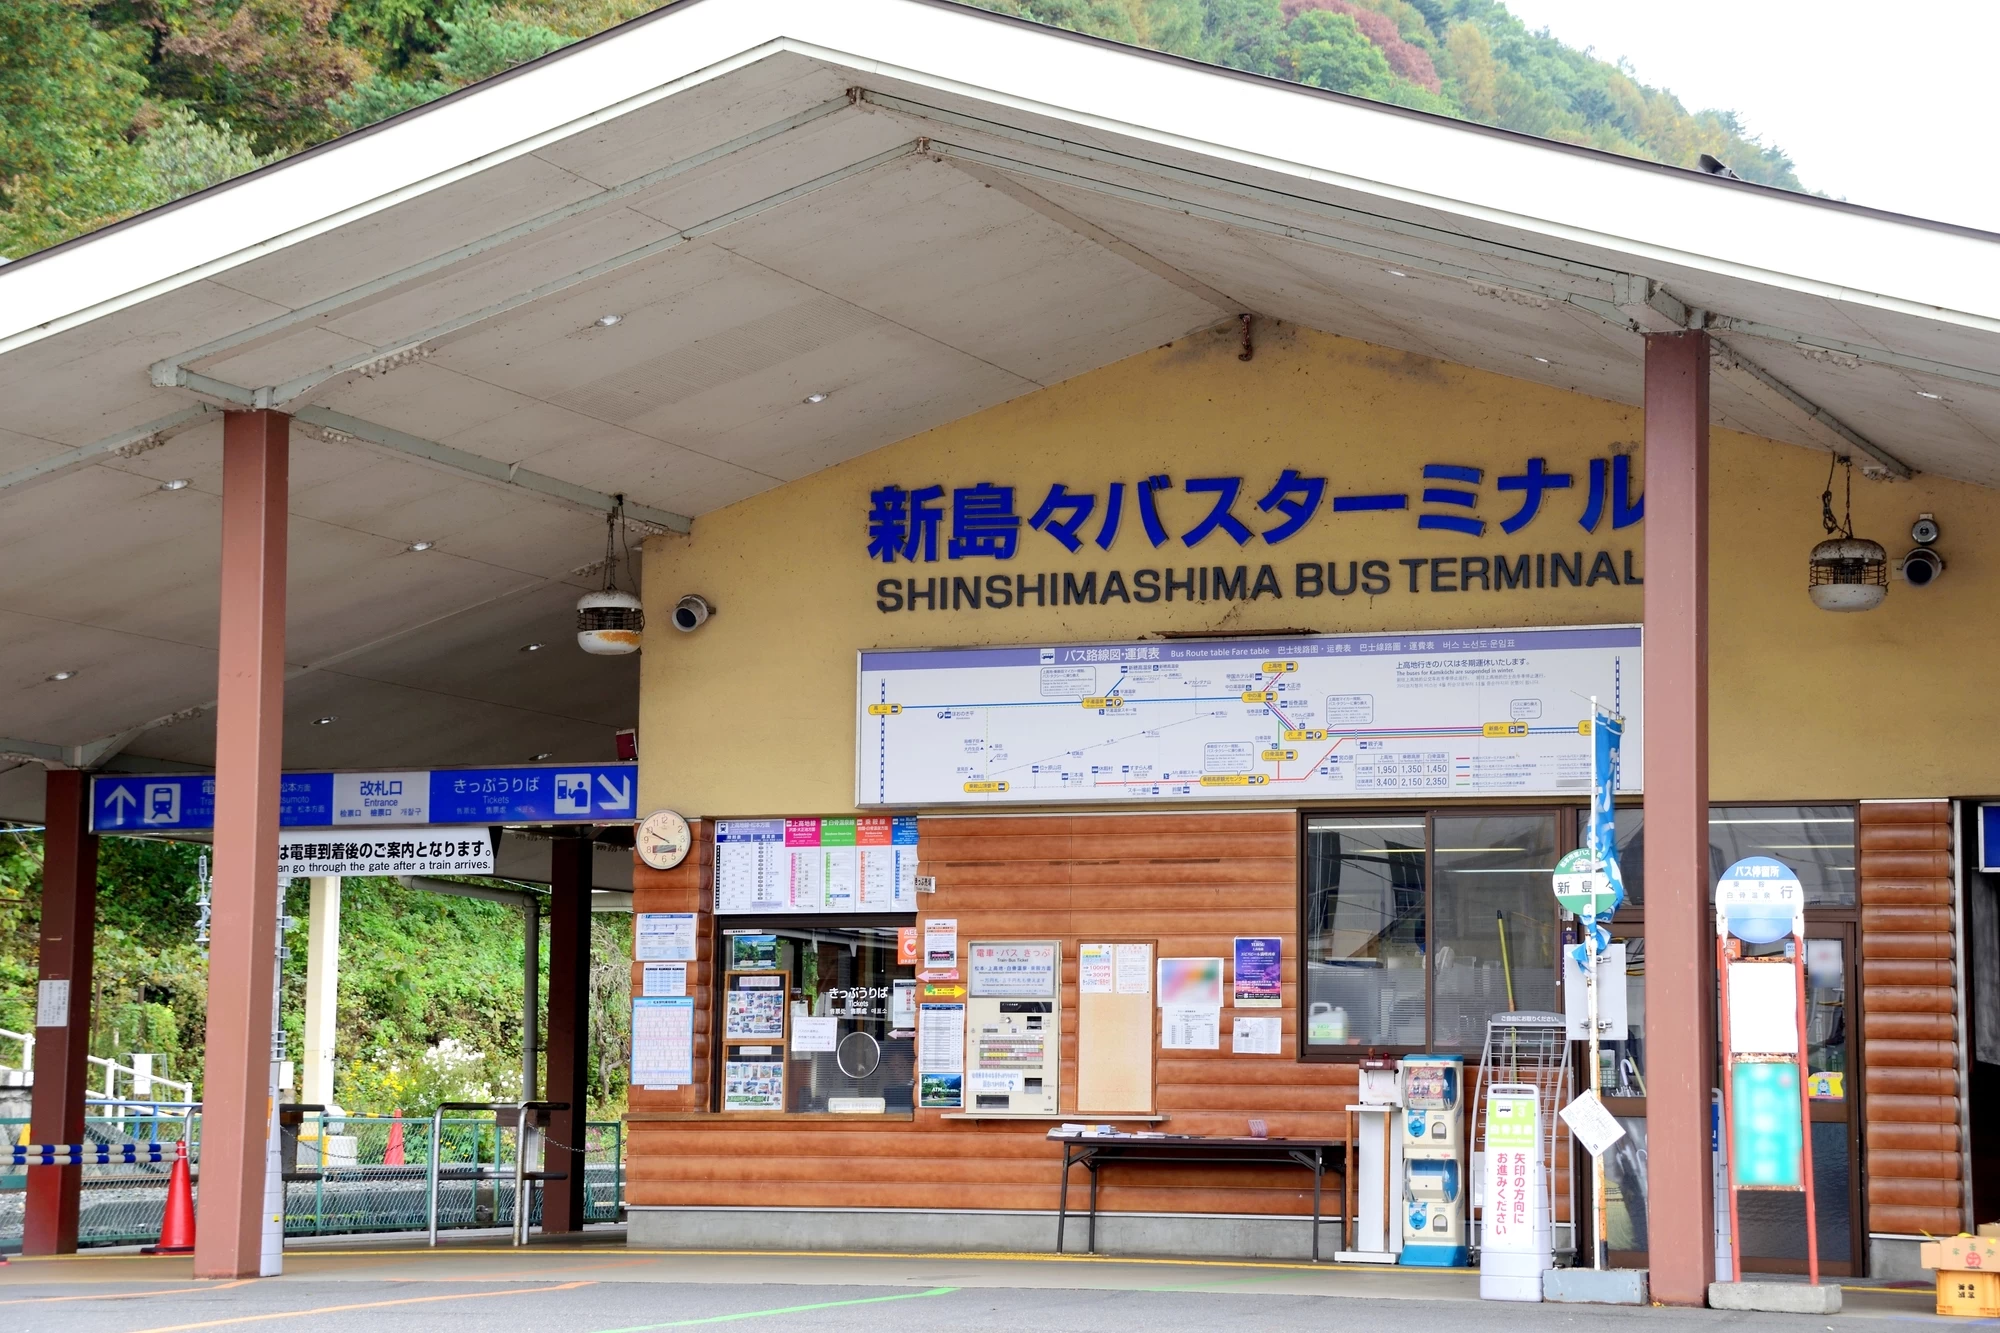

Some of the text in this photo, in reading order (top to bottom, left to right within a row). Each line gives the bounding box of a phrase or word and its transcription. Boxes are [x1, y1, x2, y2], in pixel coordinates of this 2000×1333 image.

[867, 454, 1645, 564] 新島々バスターミナル
[876, 550, 1644, 614] SHINSHIMASHIMA BUS TERMINAL
[1064, 647, 1160, 662] バス路線図・運賃表
[1171, 646, 1270, 658] Bus Route table Fare table
[1395, 658, 1530, 670] 上高地行きのバスは冬期運休いたします。
[1377, 764, 1447, 774] 1,950 1,350 1,450
[360, 780, 402, 796] 改札口
[454, 776, 540, 793] きっぷうりば
[1377, 778, 1446, 786] 3,400 2,150 2,350
[200, 796, 310, 806] Tra sumoto
[364, 798, 398, 807] Entrance
[483, 794, 510, 804] Tickets
[278, 841, 491, 860] は電車到着後のご案内となります。
[278, 865, 289, 873] an
[293, 864, 305, 874] go
[309, 862, 346, 873] through
[350, 862, 365, 871] the
[369, 862, 390, 872] gate
[393, 860, 416, 870] after
[429, 860, 451, 870] train
[454, 860, 491, 869] arrives.
[1735, 866, 1780, 877] バス停留所
[1780, 886, 1793, 898] 行
[976, 949, 1050, 957] 電車・バス きっぷ
[828, 987, 888, 999] きっぷうりば
[1518, 1106, 1525, 1117] 3
[1496, 1153, 1508, 1235] お進みください
[1514, 1153, 1526, 1224] 矢印の方向に
